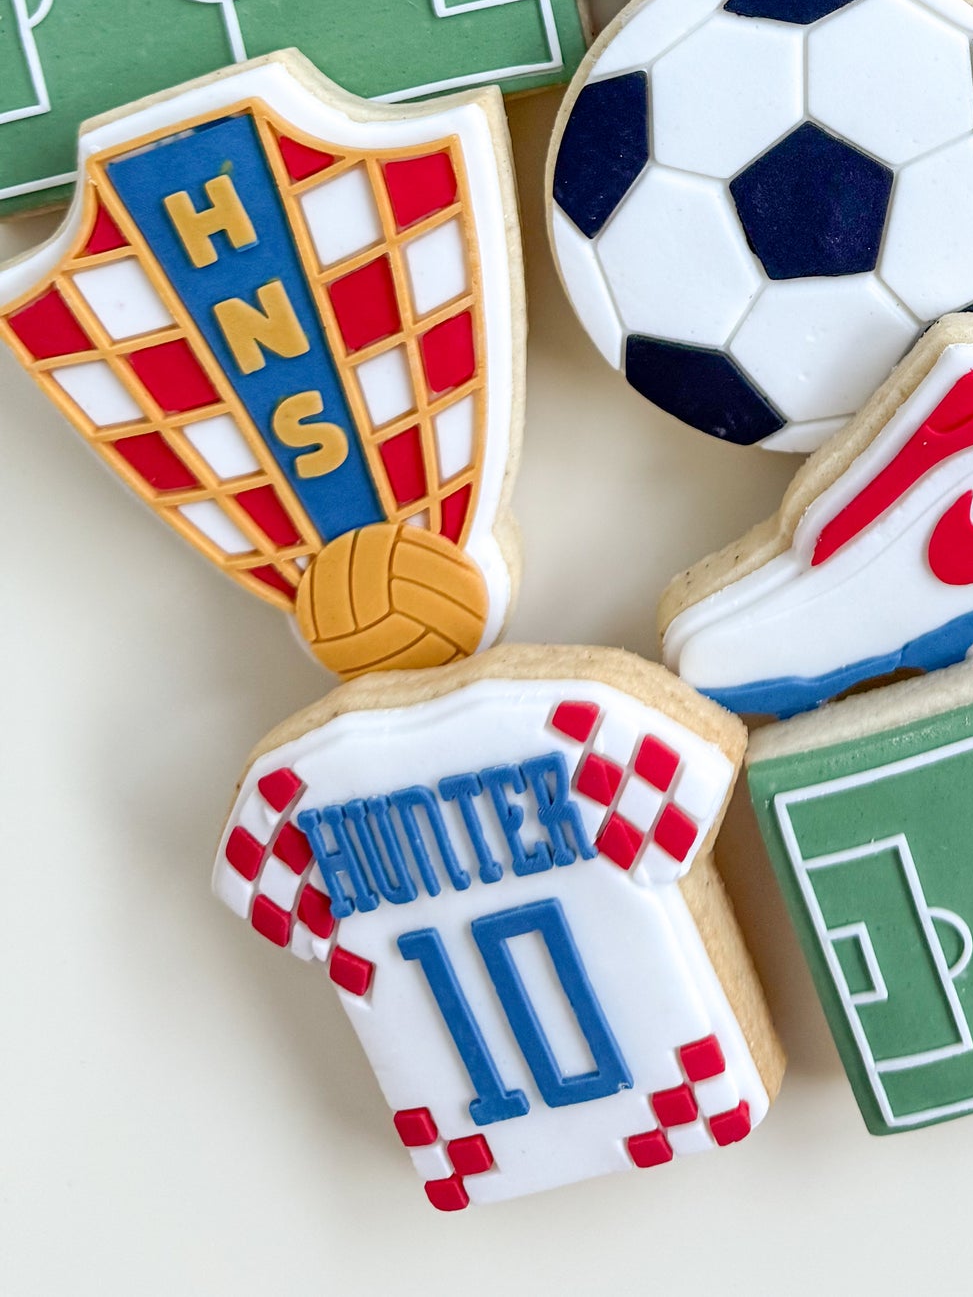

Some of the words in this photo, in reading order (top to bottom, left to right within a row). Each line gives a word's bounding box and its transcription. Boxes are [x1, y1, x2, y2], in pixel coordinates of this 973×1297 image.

[164, 174, 349, 479] HNS
[297, 751, 598, 919] HUNTER
[397, 897, 634, 1126] 10
